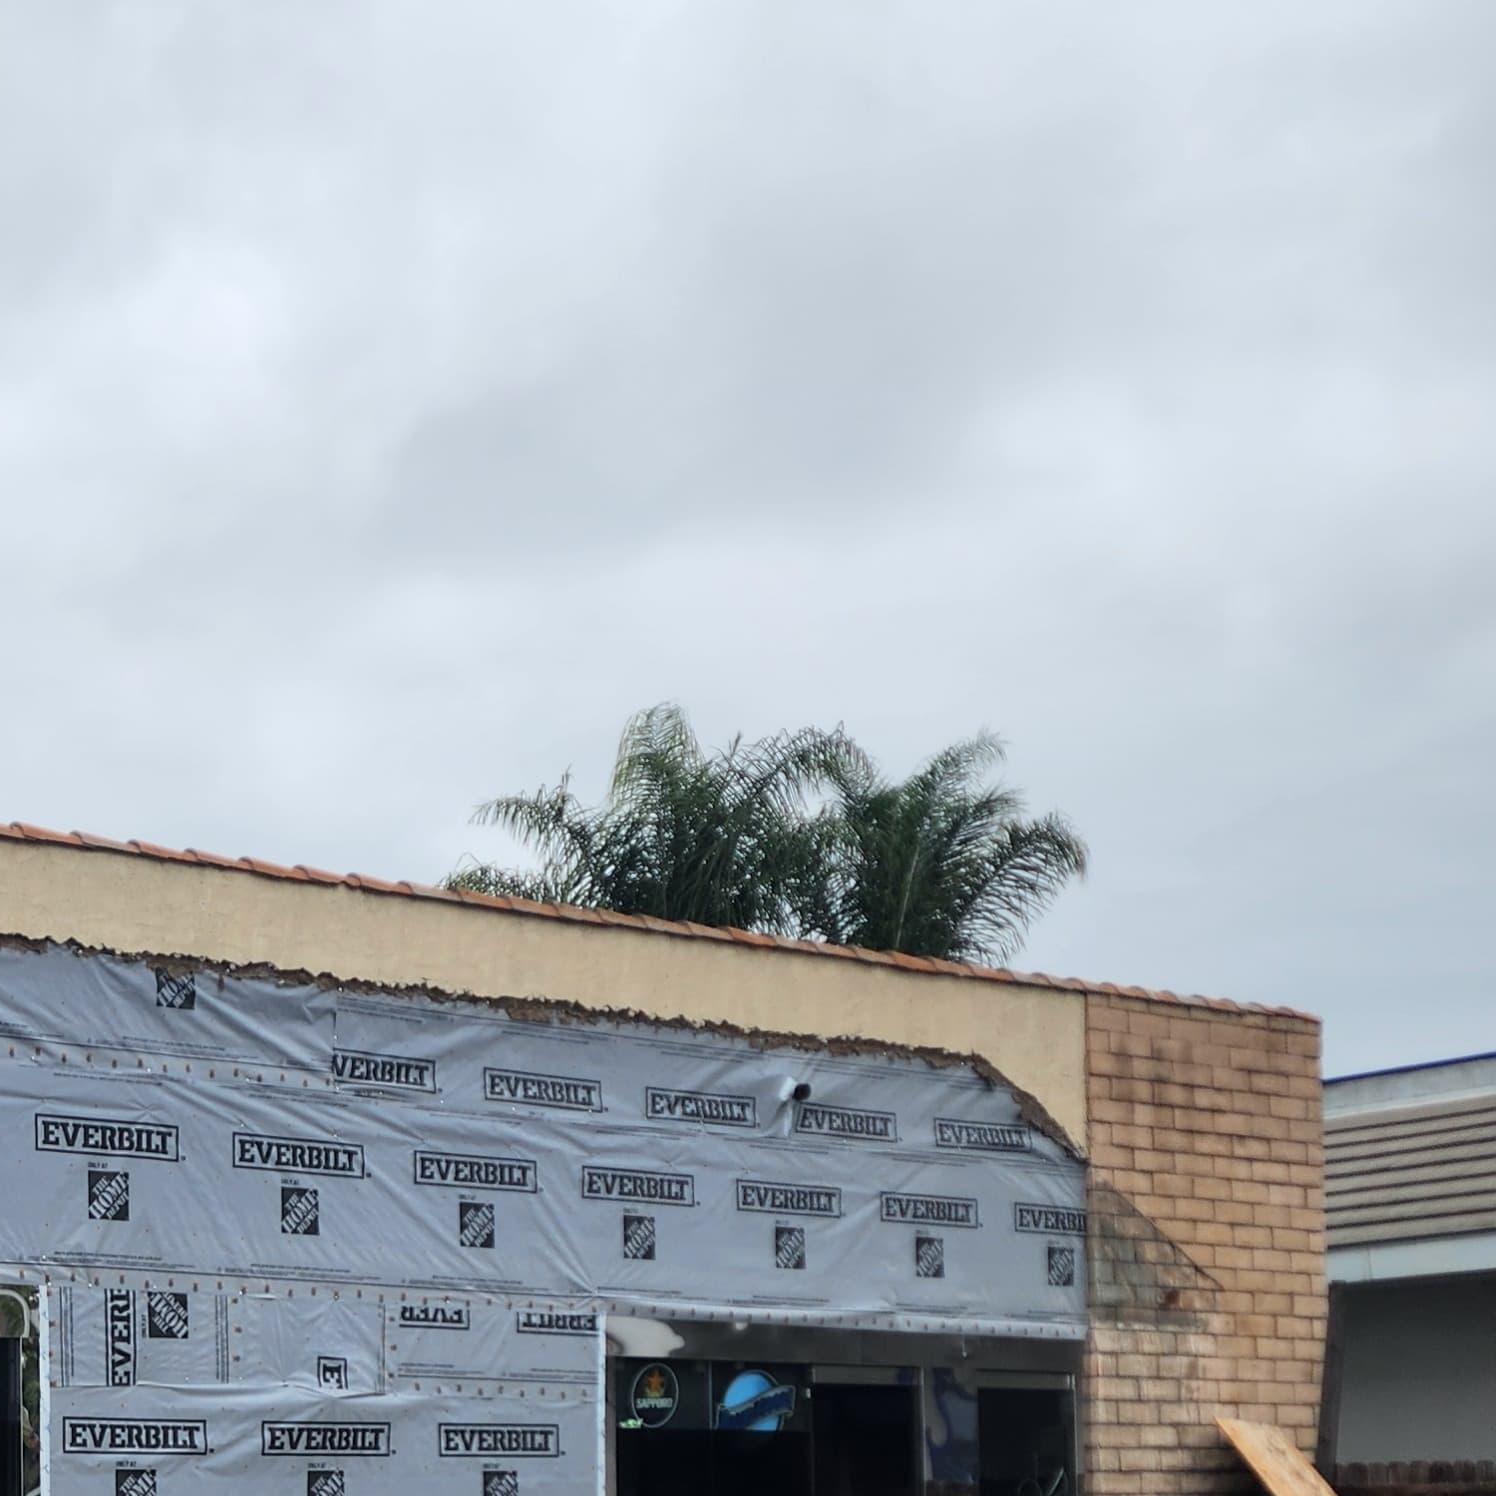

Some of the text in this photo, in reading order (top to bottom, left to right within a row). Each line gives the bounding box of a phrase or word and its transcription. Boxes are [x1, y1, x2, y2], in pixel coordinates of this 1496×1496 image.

[489, 1073, 597, 1107] EVERBILT
[651, 1092, 751, 1123] EVERBILT
[42, 1120, 173, 1154] EVERBILT
[800, 1110, 892, 1136] EVERBILT
[938, 1123, 1026, 1147] EVERBILT
[239, 1139, 358, 1172] EVERBILT
[92, 1176, 110, 1195] THE
[420, 1157, 531, 1187] EVERBILT
[587, 1172, 689, 1200] EVERBILT
[88, 1173, 129, 1219] HOME
[741, 1185, 836, 1212] EVERBILT
[885, 1197, 973, 1222] EVERBILT
[282, 1190, 318, 1233] HOME
[460, 1204, 494, 1246] HOME
[69, 1423, 201, 1450] EVERBILT
[268, 1427, 386, 1451] EVERBILT
[444, 1429, 554, 1451] EVERBILT
